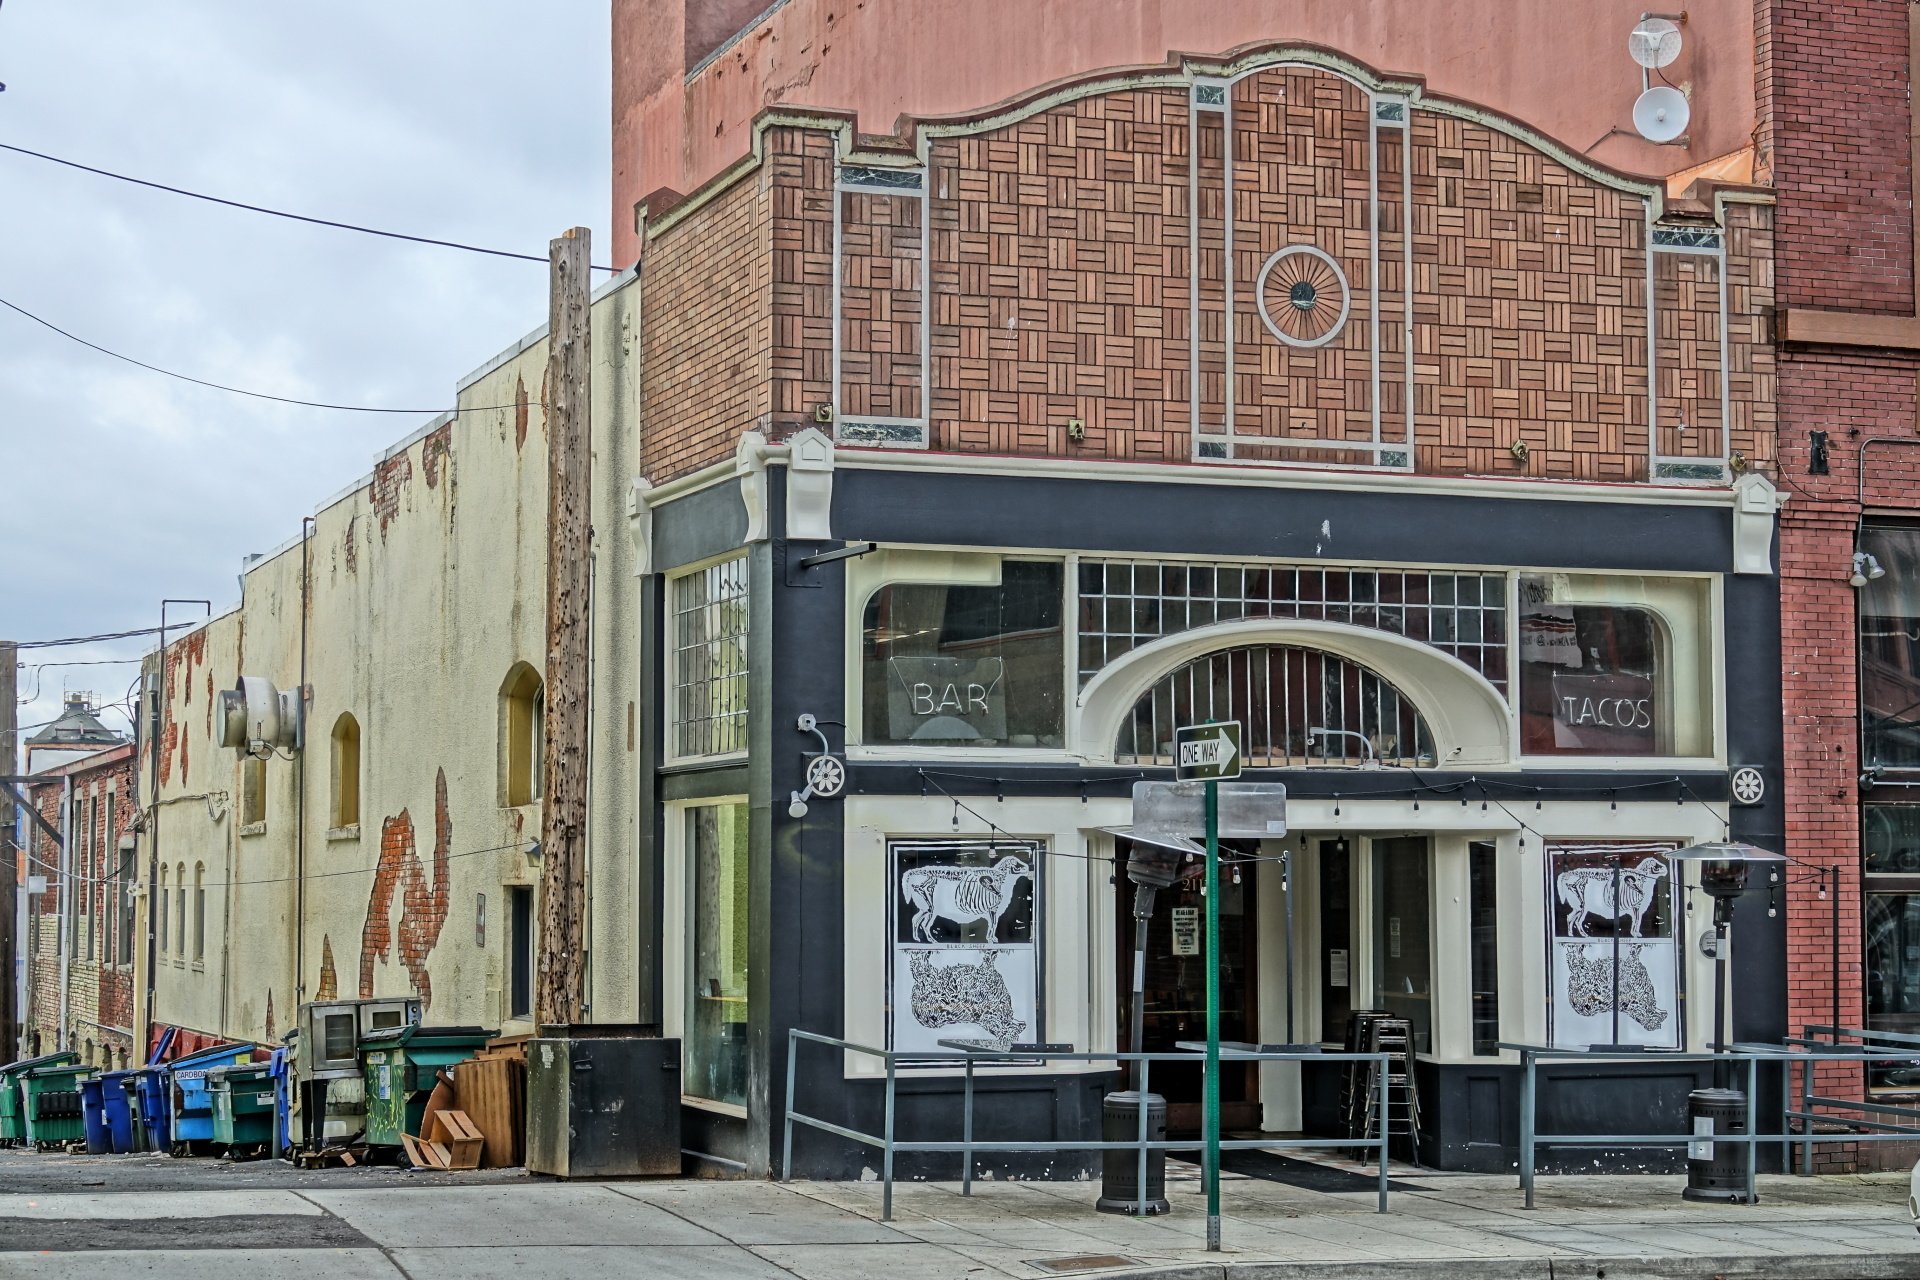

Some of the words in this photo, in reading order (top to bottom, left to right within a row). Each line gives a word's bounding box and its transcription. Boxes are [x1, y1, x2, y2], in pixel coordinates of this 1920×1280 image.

[914, 682, 989, 715] BAR
[1563, 696, 1651, 728] TACOS
[1182, 744, 1199, 764] ONE
[1201, 741, 1220, 763] WAY
